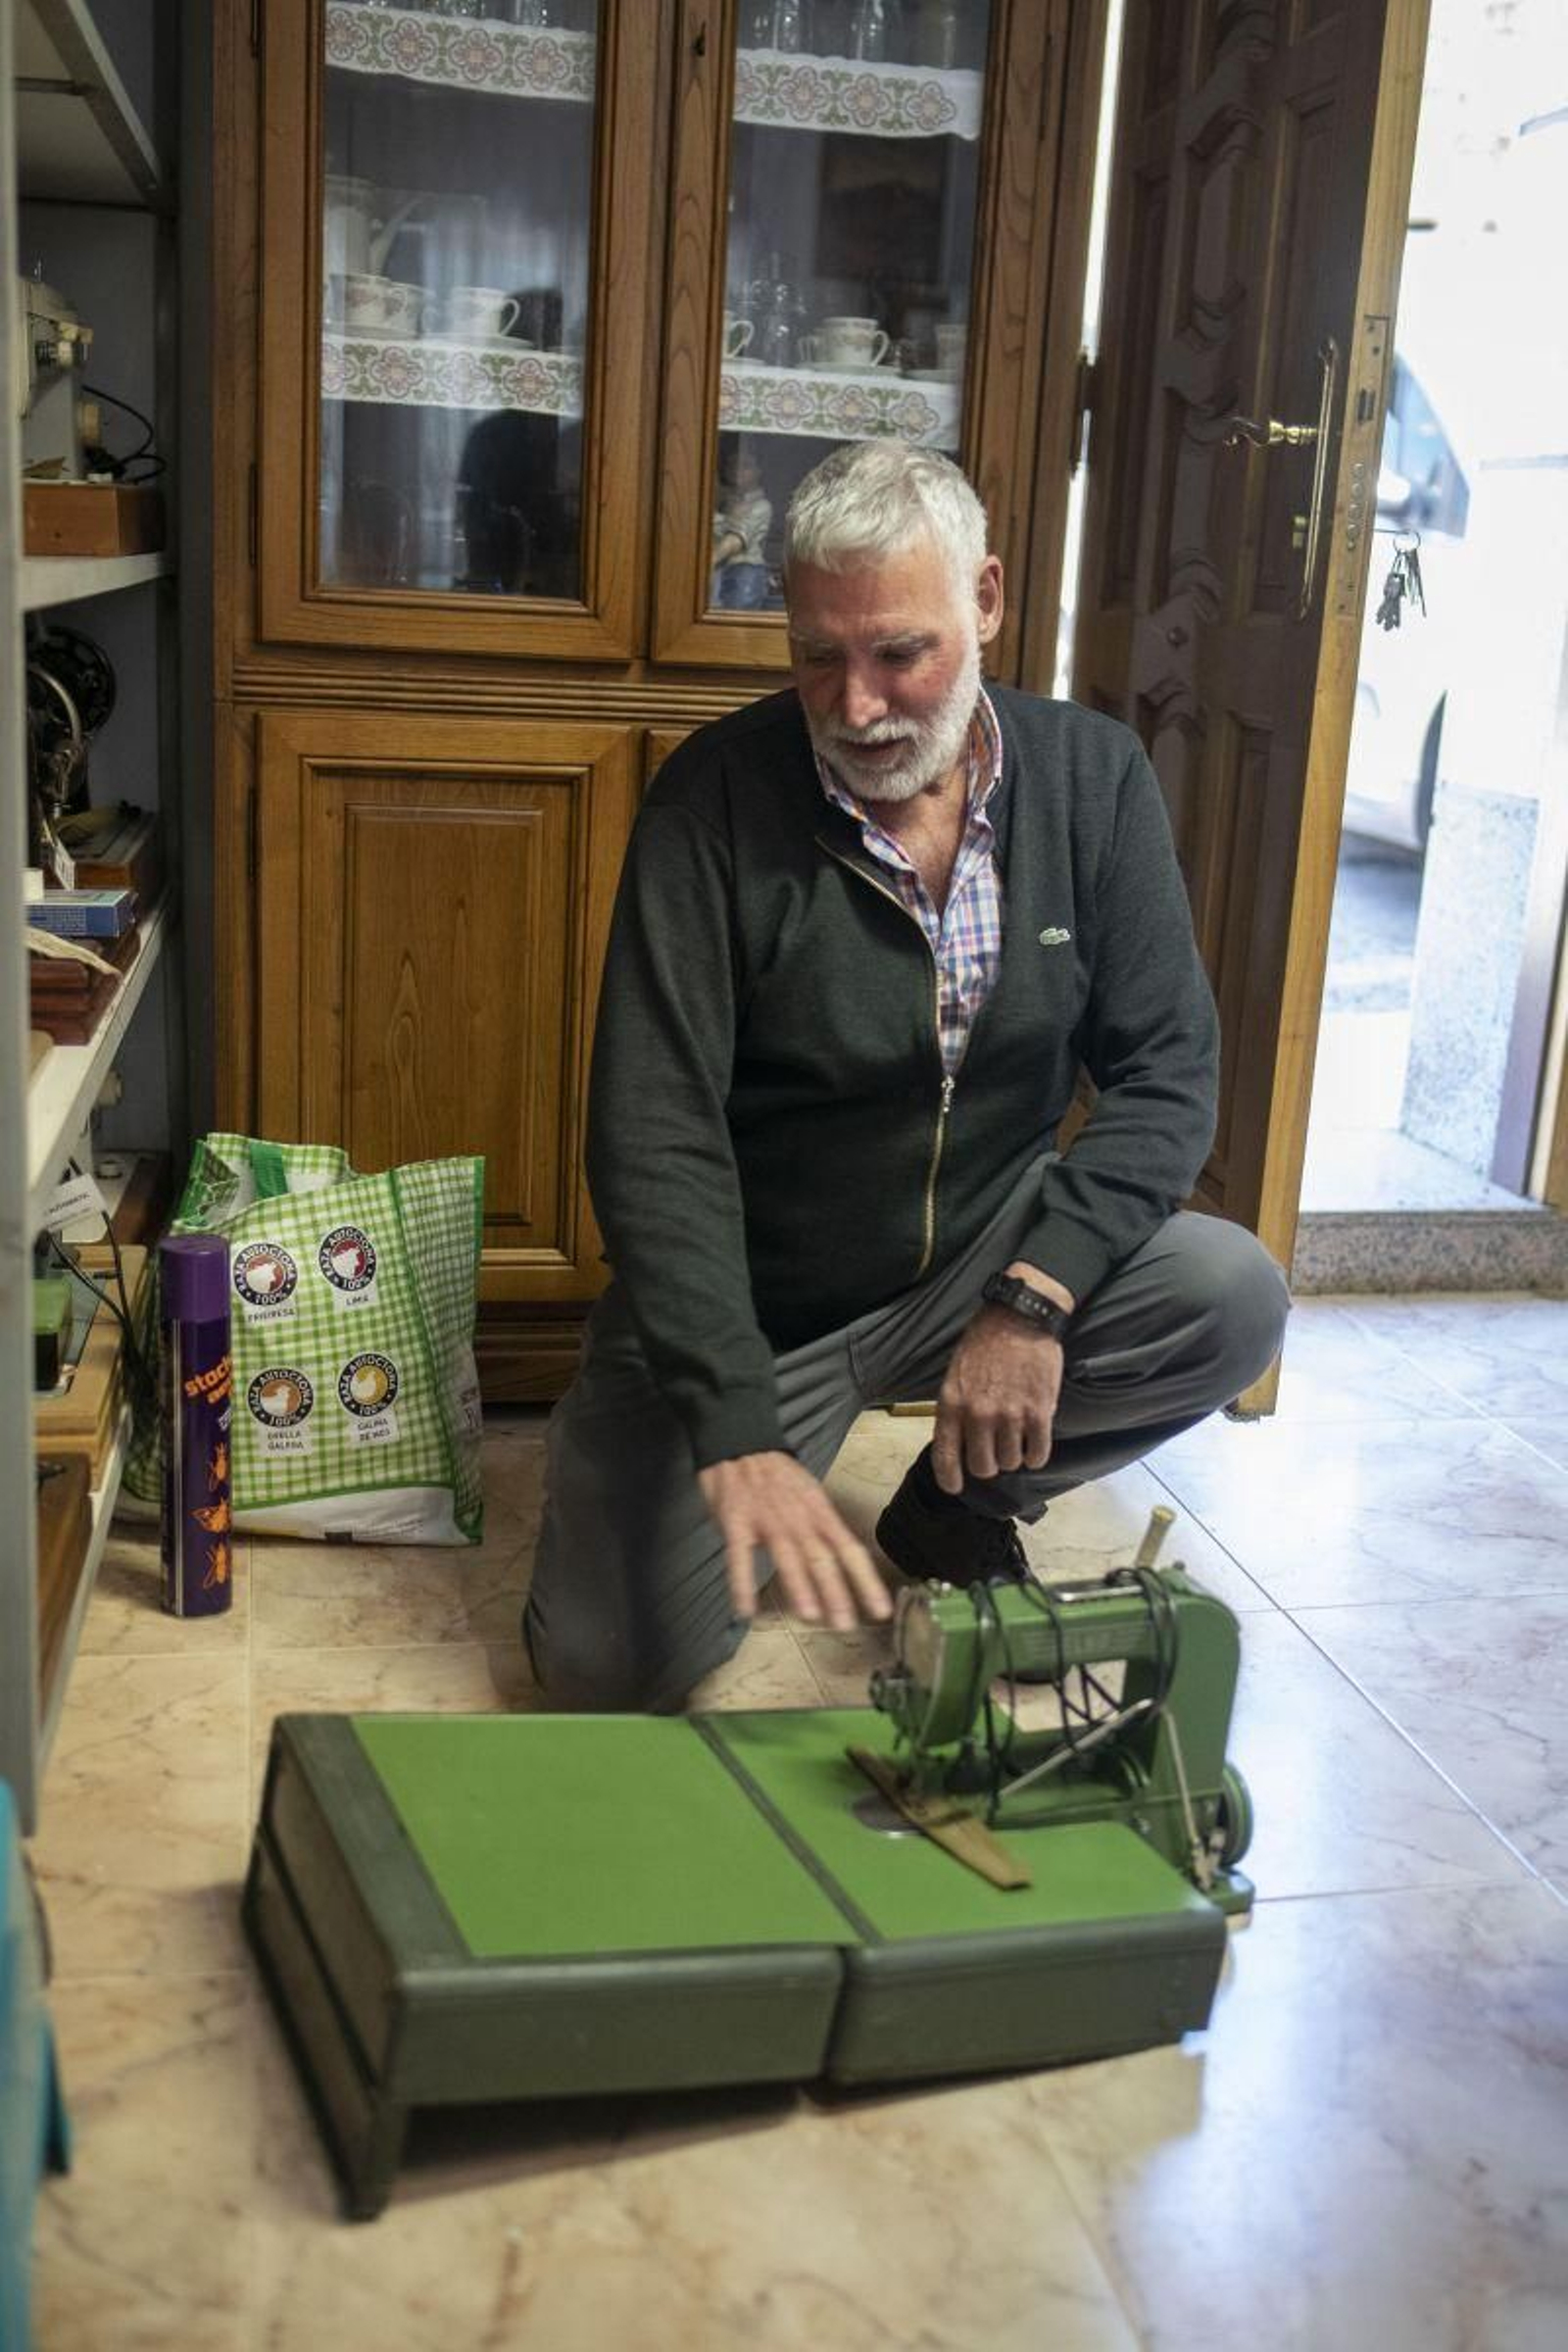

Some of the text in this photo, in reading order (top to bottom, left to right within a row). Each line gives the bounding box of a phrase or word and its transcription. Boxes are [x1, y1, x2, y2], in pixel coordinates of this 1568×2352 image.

[342, 1275, 371, 1290] 100%
[255, 1289, 288, 1306] 100%
[359, 1401, 389, 1416] 100%
[270, 1412, 302, 1427] 100%
